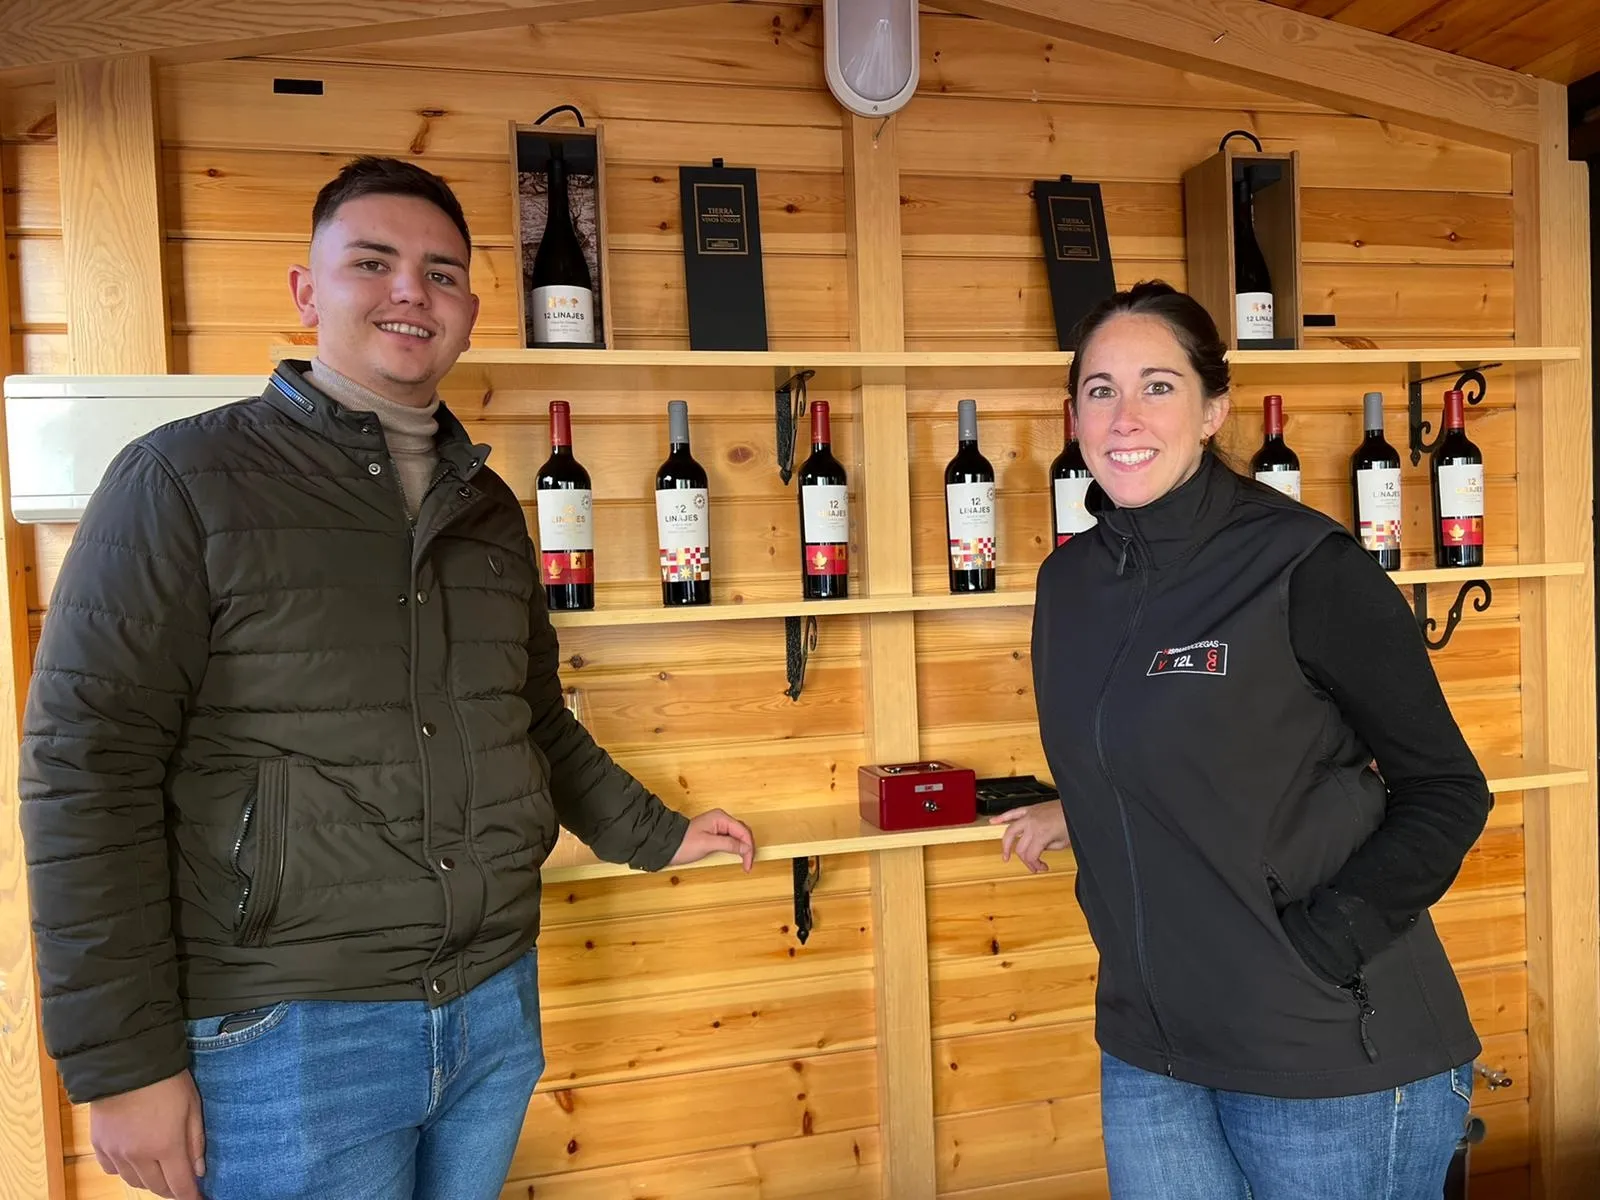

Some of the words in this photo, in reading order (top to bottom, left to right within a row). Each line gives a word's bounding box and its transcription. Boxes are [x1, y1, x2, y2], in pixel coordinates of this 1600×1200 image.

[707, 207, 734, 215] TIERRA
[544, 312, 551, 320] 12
[553, 311, 585, 320] LINAJES
[1384, 482, 1394, 490] 12
[830, 500, 839, 509] 12
[971, 497, 981, 506] 12
[552, 515, 585, 523] LINES
[665, 514, 699, 522] LINAJES
[1173, 655, 1194, 668] 12L
